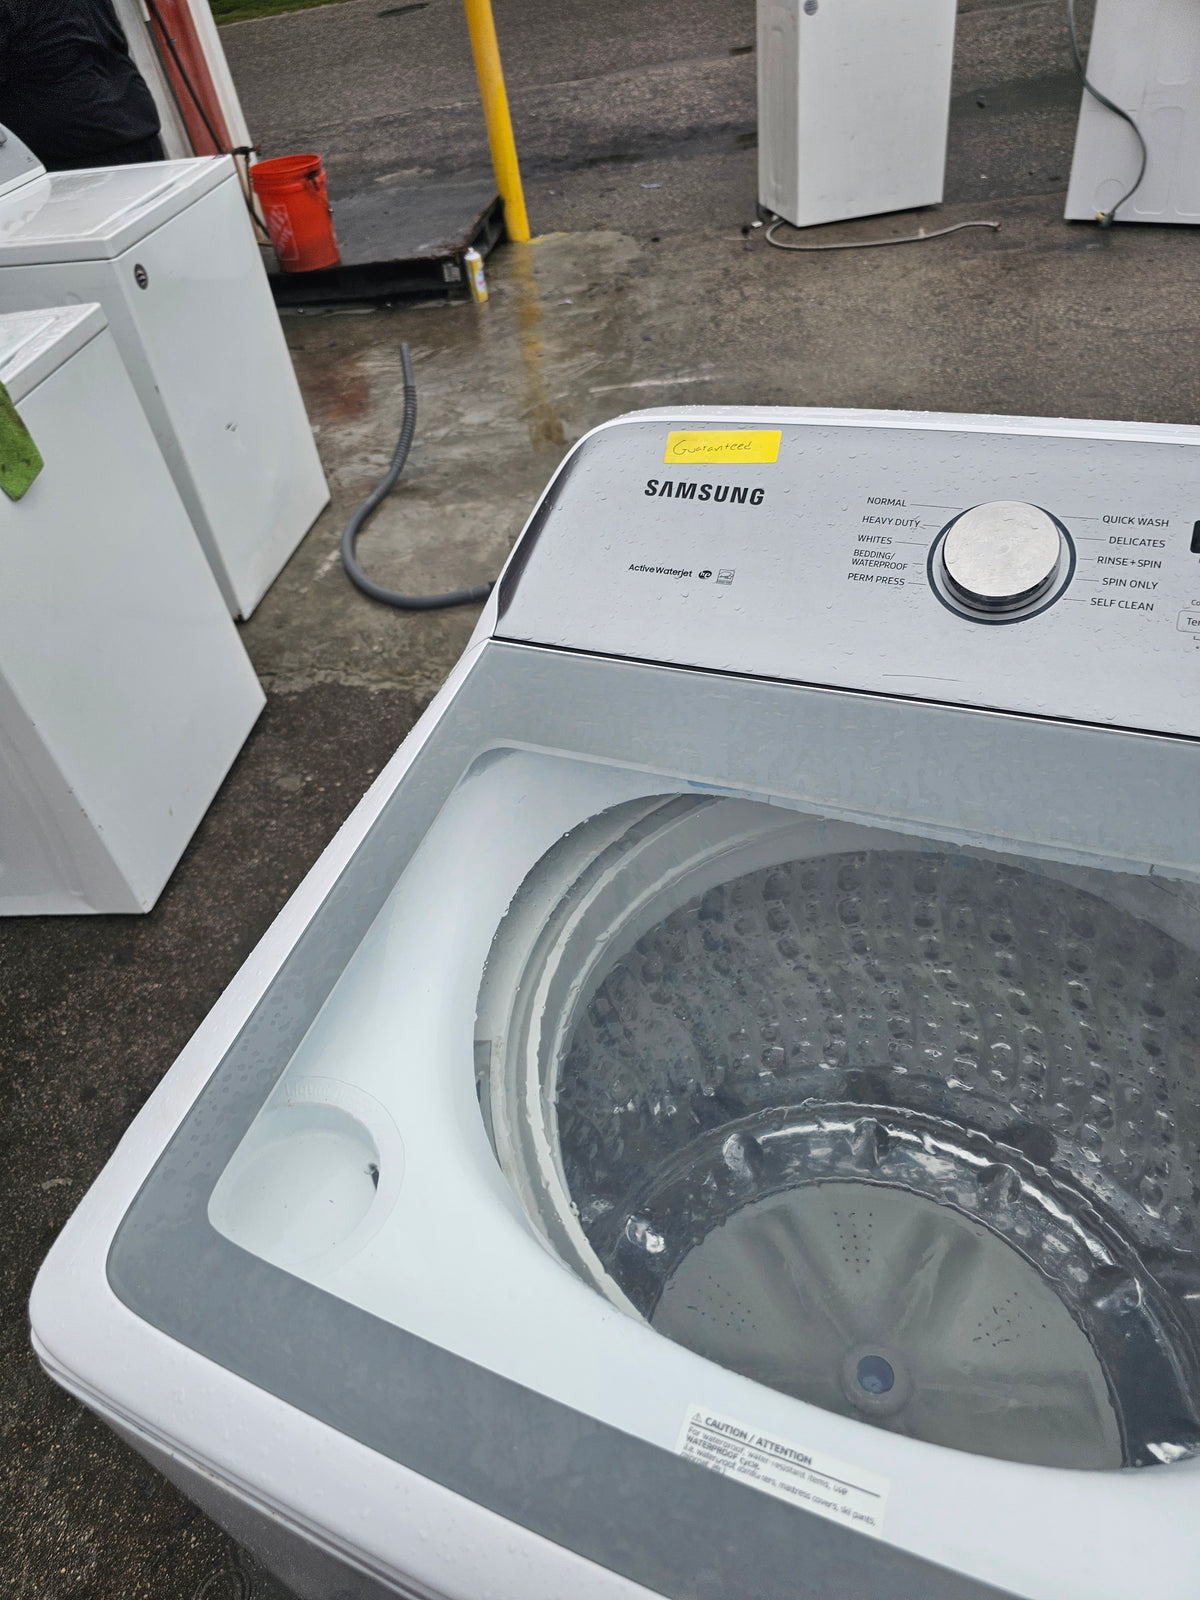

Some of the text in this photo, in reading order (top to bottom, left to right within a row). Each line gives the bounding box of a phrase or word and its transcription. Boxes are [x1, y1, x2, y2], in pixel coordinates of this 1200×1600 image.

[672, 439, 753, 455] Guaranteed
[644, 479, 765, 506] SAMSUNG
[867, 497, 907, 507] NORMAL
[862, 515, 920, 527] HEAVY DUTY
[1102, 515, 1169, 527] QUICK WASH
[858, 535, 892, 545] WHITES
[1108, 536, 1166, 548] DELICATES
[853, 549, 895, 560] BEDDING/
[852, 558, 908, 570] WATERPROOF
[1097, 555, 1129, 566] RINSE
[1137, 559, 1162, 569] SPIN
[847, 572, 905, 586] PERM PRESS
[1102, 577, 1158, 590] SPIN ONLY
[1090, 597, 1154, 611] SELF CLEAN
[704, 1416, 747, 1439] CAUTION
[756, 1437, 812, 1465] ATTENTION
